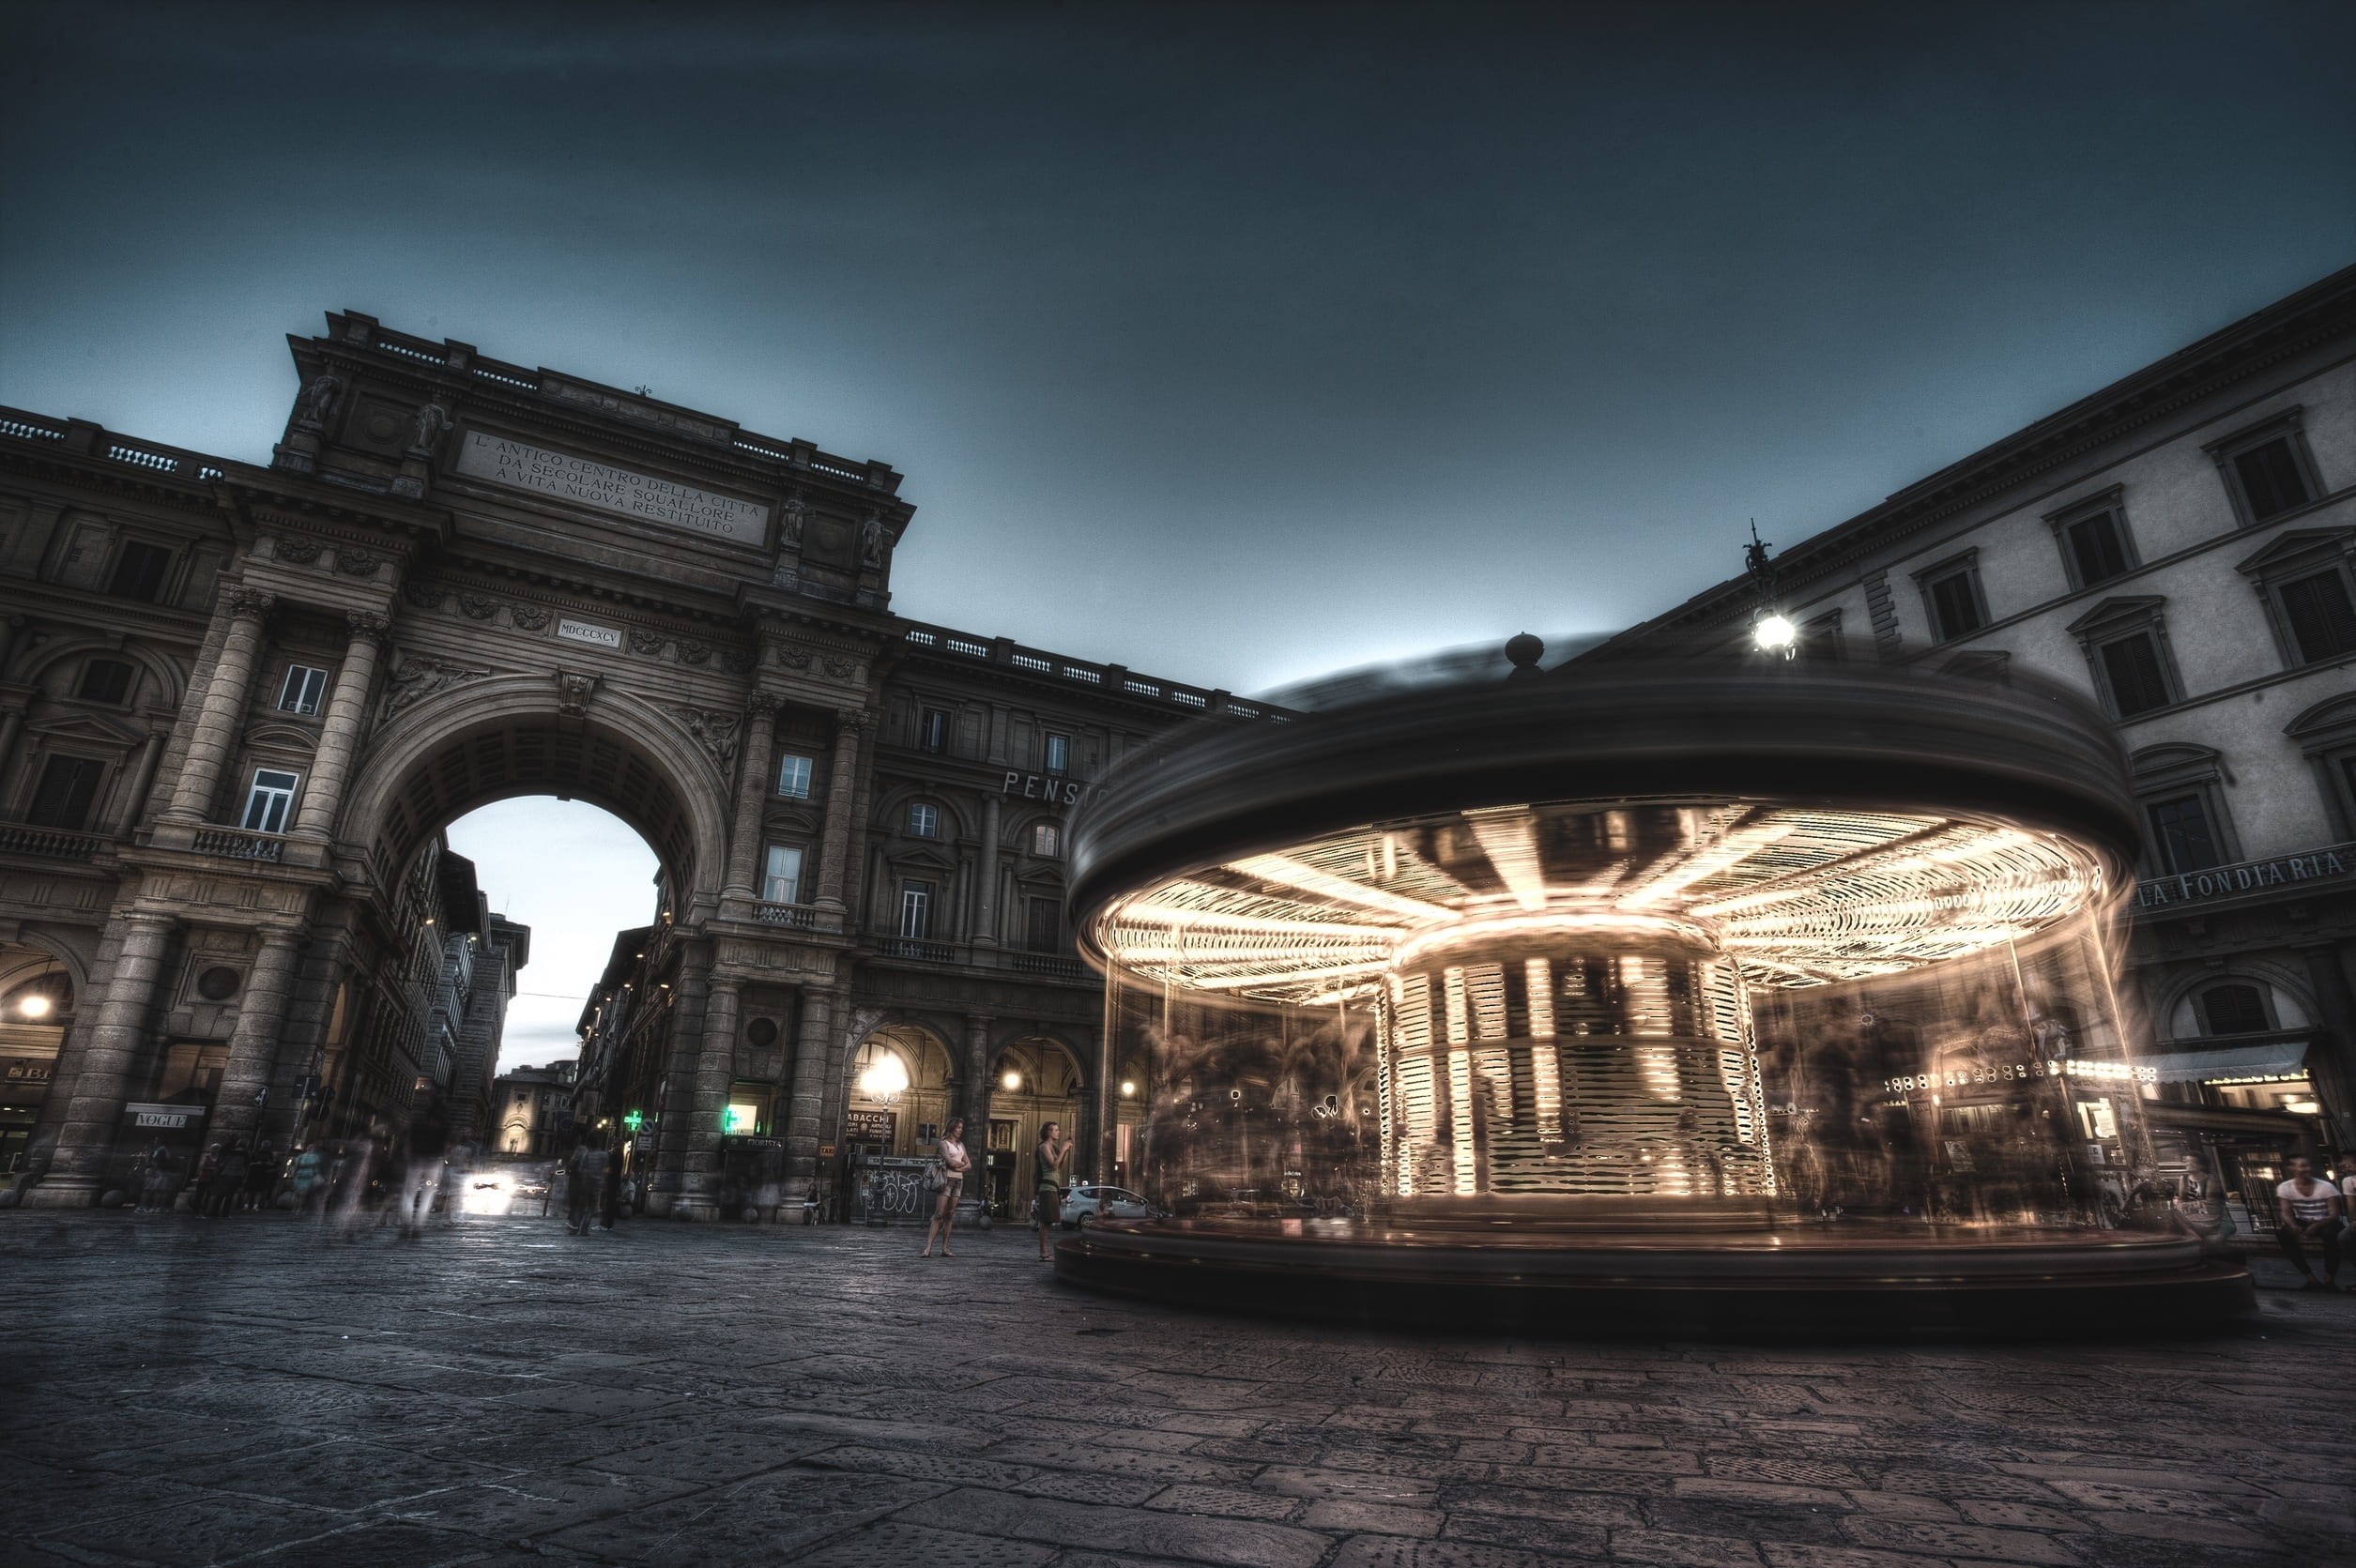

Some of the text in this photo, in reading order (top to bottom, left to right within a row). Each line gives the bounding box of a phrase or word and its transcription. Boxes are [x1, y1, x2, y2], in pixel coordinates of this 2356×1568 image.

[496, 442, 563, 466] ANTICO
[570, 460, 640, 485] CENTRO
[648, 480, 703, 503] DELLA
[496, 467, 733, 534] A VITA NUOVA RESTITUITO
[498, 454, 735, 522] DA SECOLARE SQUALLORE
[561, 624, 617, 642] MDCCCXCV
[2137, 851, 2346, 907] LA FONDIARIA
[138, 1113, 186, 1127] VOGUE
[848, 1113, 889, 1123] ABACCHI
